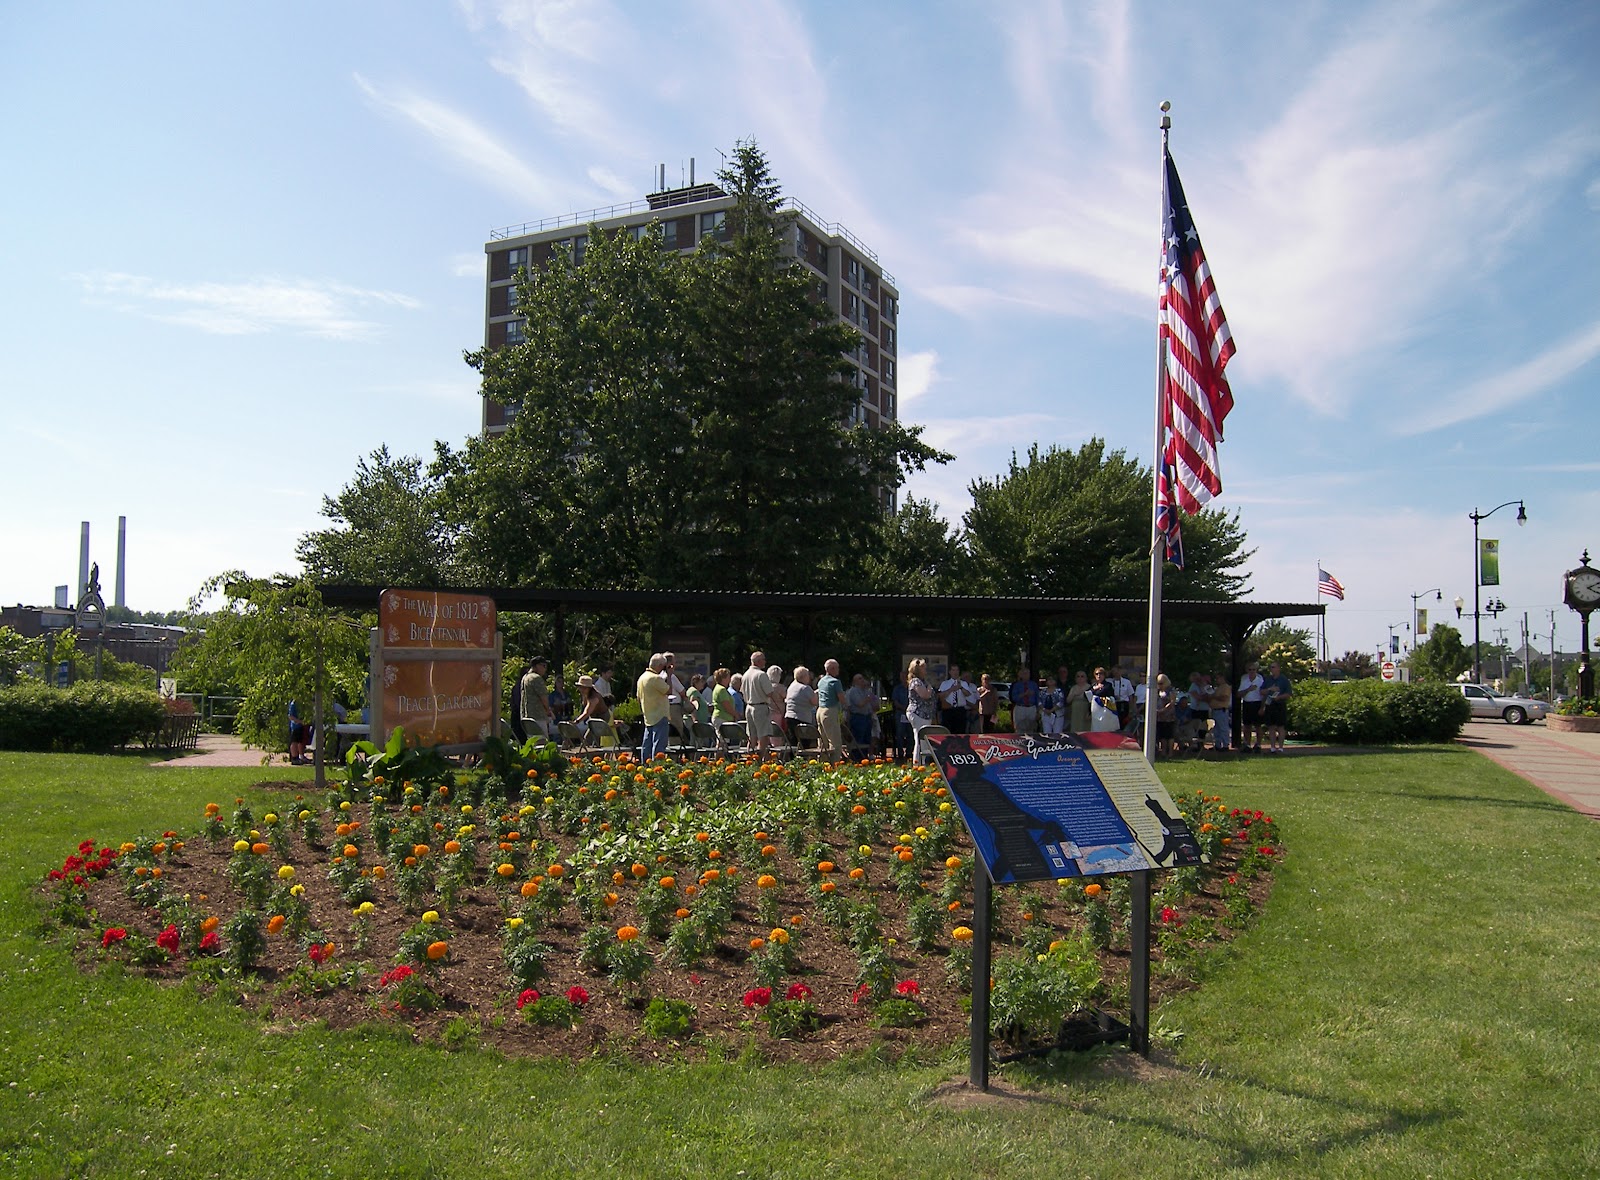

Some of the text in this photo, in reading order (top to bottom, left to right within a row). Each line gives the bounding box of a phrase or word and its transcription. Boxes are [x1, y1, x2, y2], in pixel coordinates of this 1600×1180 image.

[403, 598, 478, 620] THE WAR OF 1812
[410, 622, 471, 642] BICENTENNIAL
[398, 693, 482, 713] PEACE GARDEN
[949, 739, 1075, 765] 1812 Peace Garden
